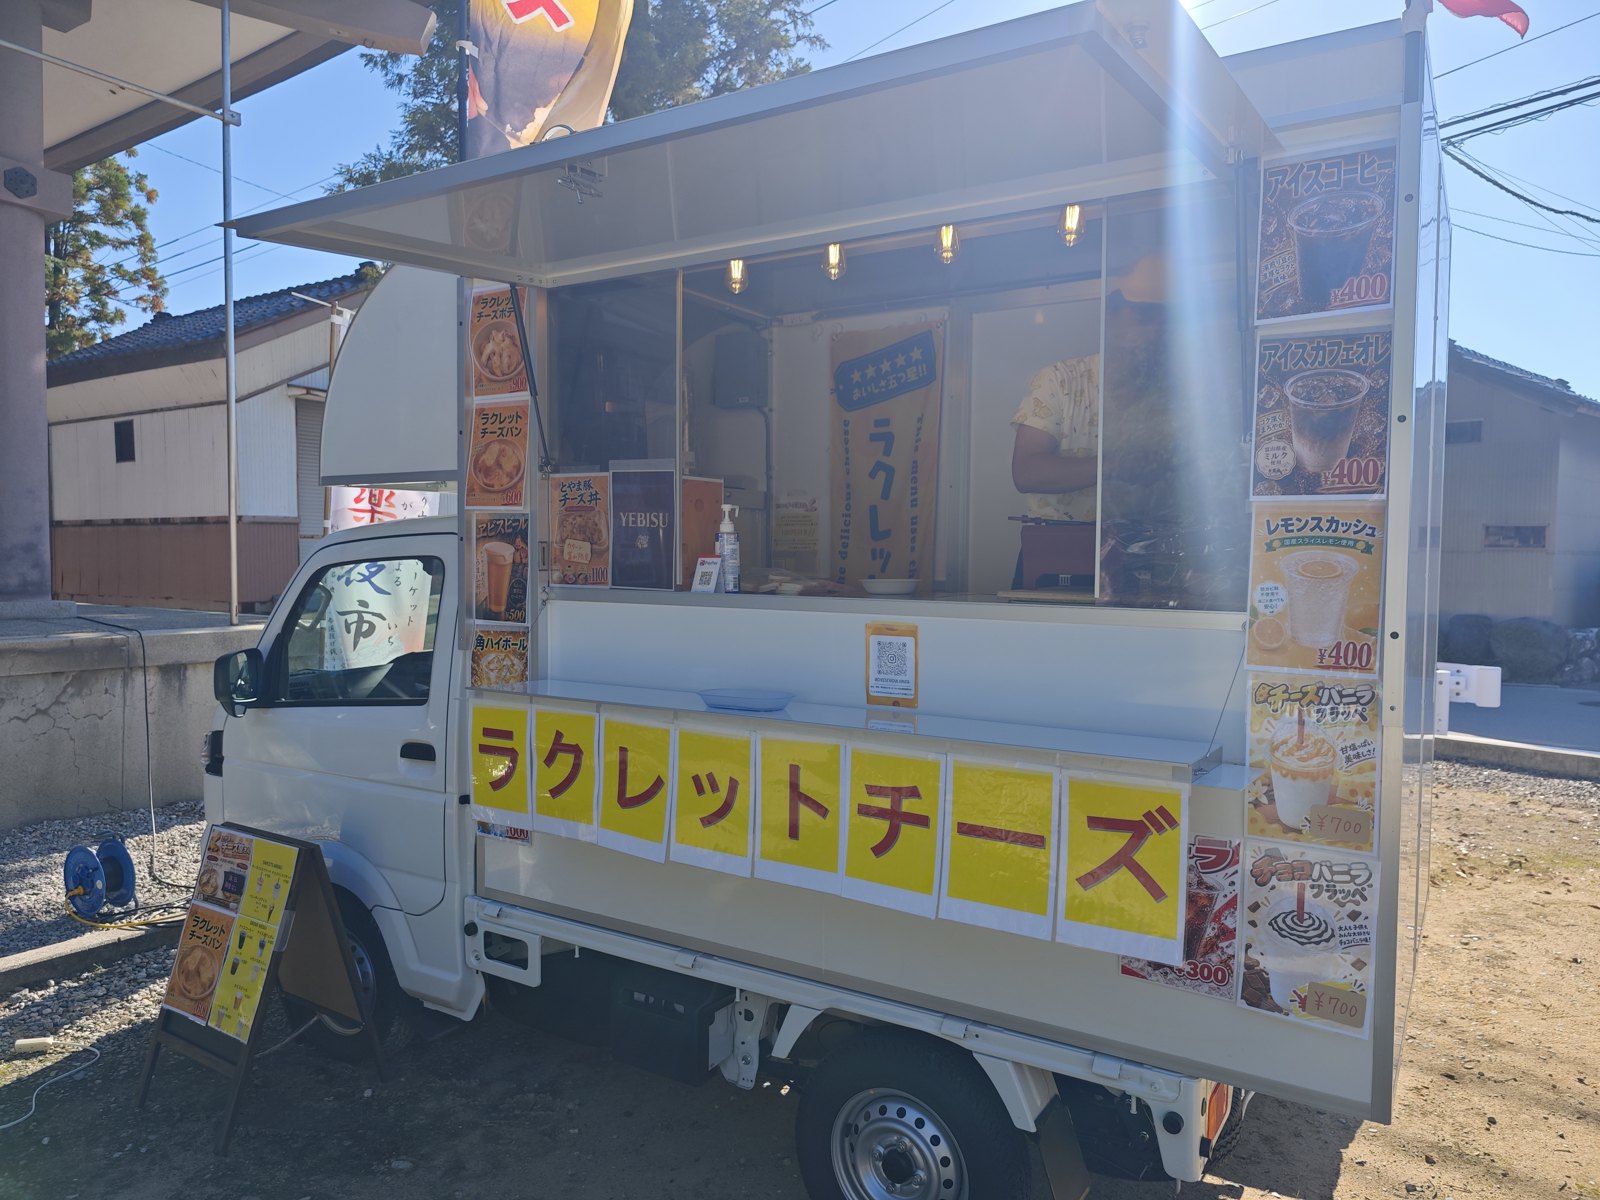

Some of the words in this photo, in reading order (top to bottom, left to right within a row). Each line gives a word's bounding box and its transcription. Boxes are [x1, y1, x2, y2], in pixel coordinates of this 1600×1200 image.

[1266, 152, 1395, 200] アイスコーヒー
[1331, 273, 1388, 303] ¥400
[481, 296, 514, 310] ラクレッ
[1262, 335, 1391, 372] アイスカフェオレ
[480, 411, 522, 426] ラクレット
[1264, 452, 1288, 460] ミルク
[1322, 458, 1380, 486] ¥400
[560, 479, 593, 493] とやま豚
[910, 459, 920, 509] menu
[558, 491, 601, 508] チーズ丼
[868, 418, 896, 579] ラクレッ
[619, 512, 669, 529] YEBISU
[838, 484, 851, 561] delicious
[1265, 515, 1378, 538] レモンスカッシュ
[1284, 537, 1354, 547] 国産スライスレモン使用
[408, 560, 419, 627] ーケット
[474, 634, 528, 651] 角ハイボール
[1318, 640, 1373, 668] ¥400
[1268, 682, 1376, 712] チーズバニラ
[1315, 706, 1368, 723] フラッペ
[1340, 739, 1374, 755] 甘塩っぱい
[1344, 748, 1376, 765] 美味しさ!
[478, 727, 1179, 903] ラクレットチーズ
[1317, 814, 1362, 835] ¥700
[1250, 854, 1373, 887] チョコバニラ
[192, 915, 226, 937] ラクレット
[1315, 991, 1358, 1018] ¥700
